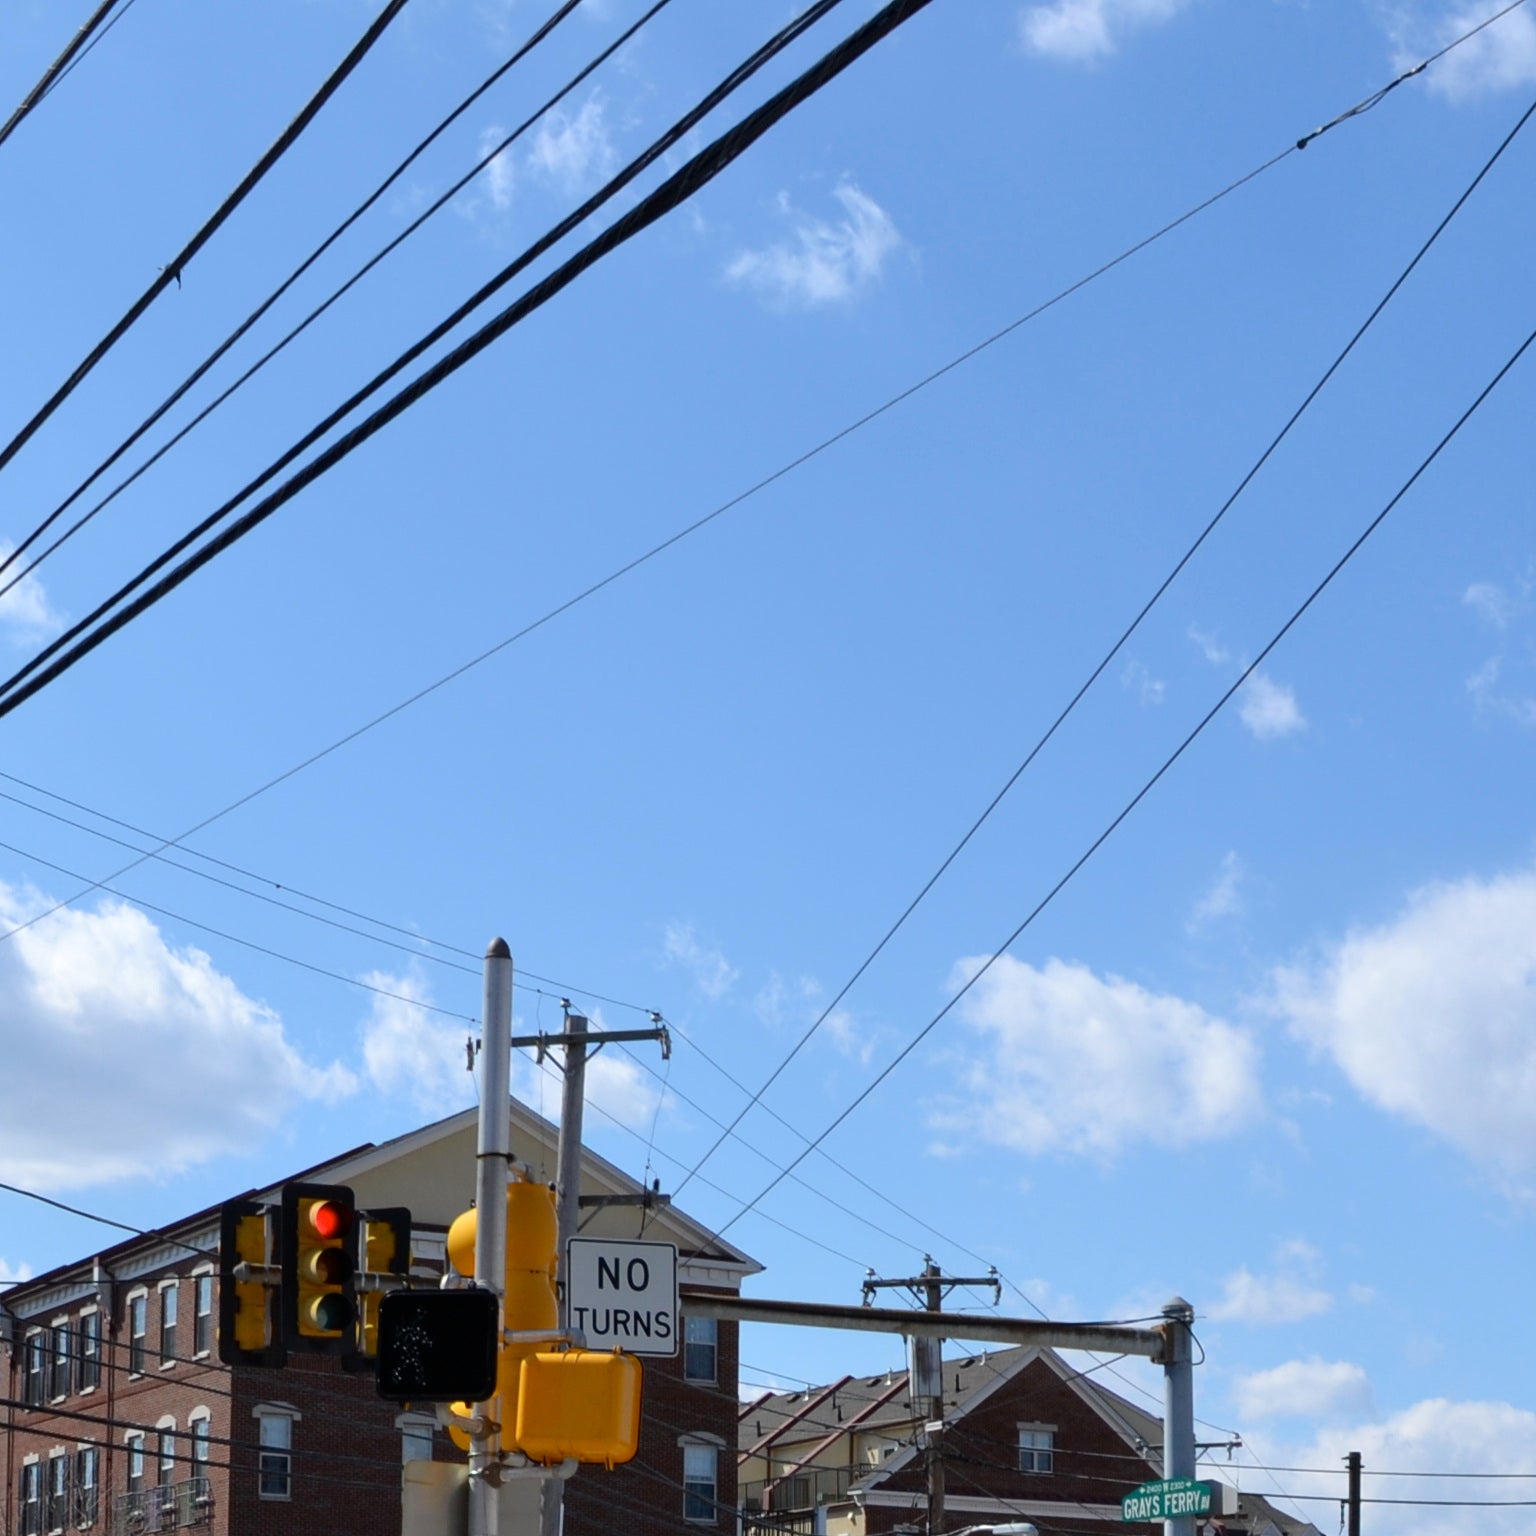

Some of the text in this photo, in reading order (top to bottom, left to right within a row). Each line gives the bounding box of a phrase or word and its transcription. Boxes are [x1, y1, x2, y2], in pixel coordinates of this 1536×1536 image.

[598, 1256, 650, 1292] NO
[573, 1307, 671, 1338] TURNS
[1146, 1484, 1162, 1494] 2400
[1170, 1481, 1184, 1490] 2300
[1124, 1490, 1211, 1519] GRAYS FERRY AV
